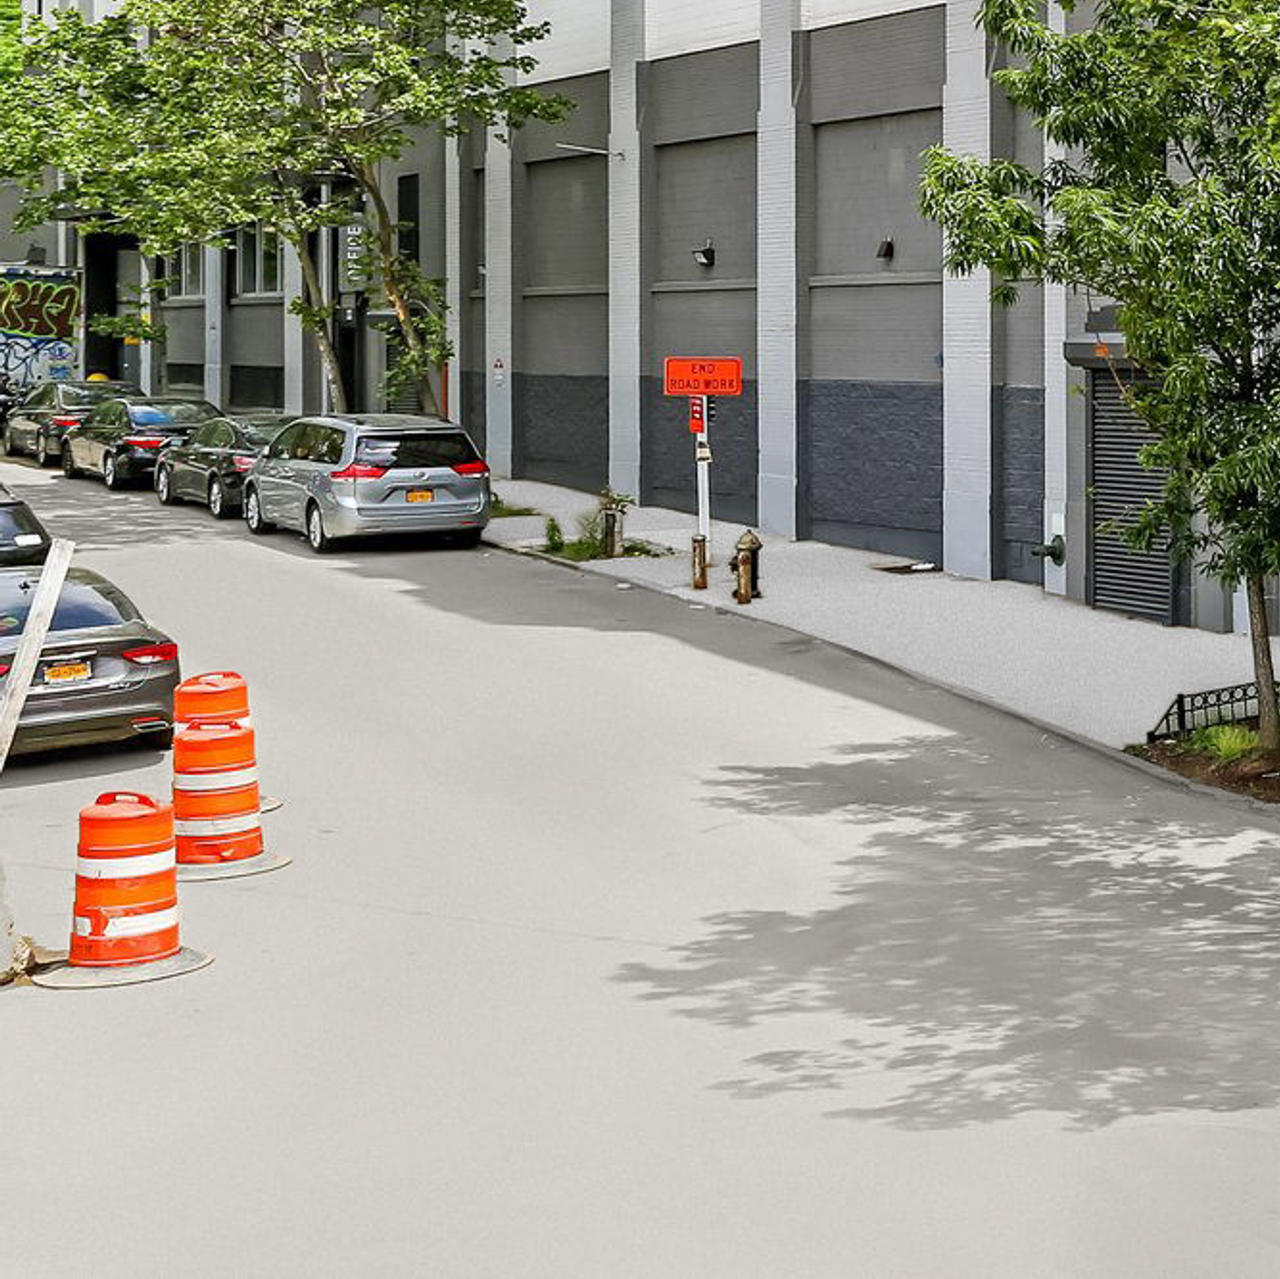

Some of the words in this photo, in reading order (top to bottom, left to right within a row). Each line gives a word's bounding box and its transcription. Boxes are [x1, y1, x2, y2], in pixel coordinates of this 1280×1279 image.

[691, 363, 716, 374] END
[670, 379, 700, 390] ROAD
[704, 379, 735, 390] WORK
